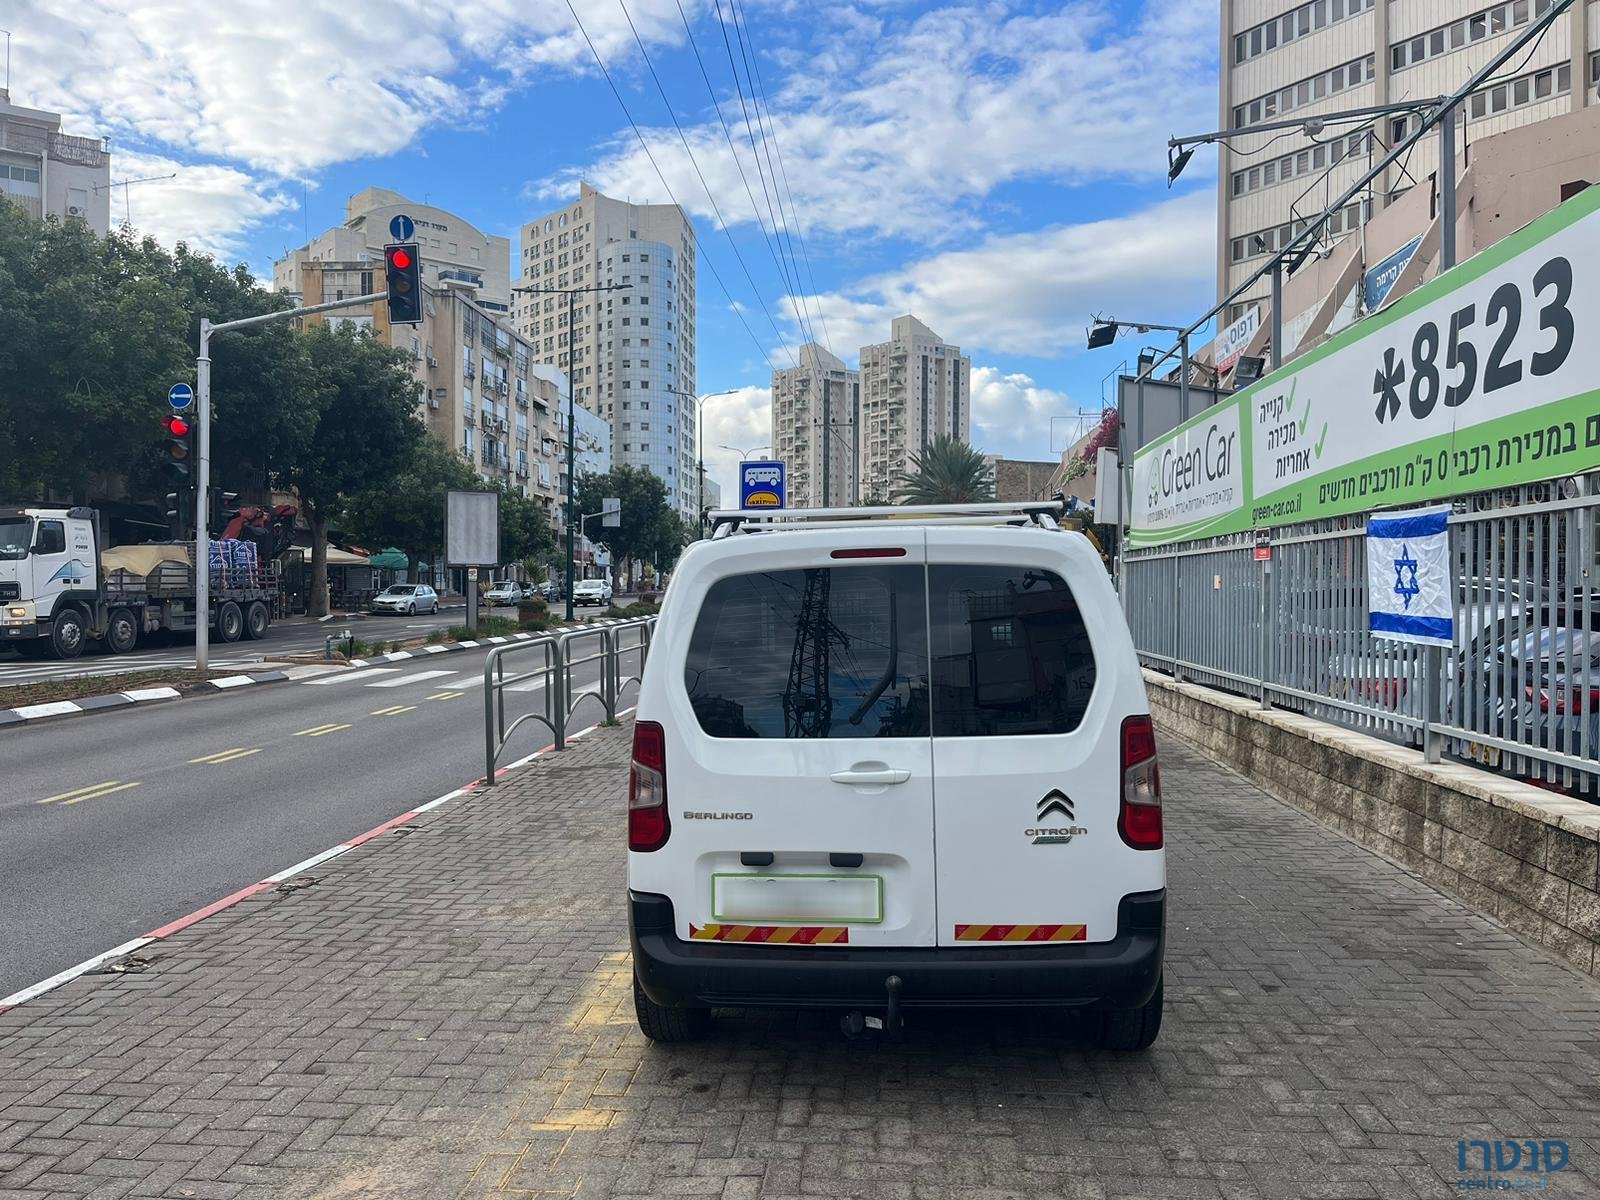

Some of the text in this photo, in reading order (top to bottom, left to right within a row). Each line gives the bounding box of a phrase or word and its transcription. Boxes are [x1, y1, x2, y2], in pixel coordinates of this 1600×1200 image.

[1230, 314, 1253, 344] דפוס
[1259, 394, 1284, 424] קנייה
[1268, 421, 1296, 451] מכירה
[1496, 421, 1577, 469] במכירת
[1162, 424, 1235, 498] Green Car
[1275, 448, 1311, 479] אחריות
[1438, 450, 1448, 481] 0
[1453, 444, 1491, 477] רכבי
[1319, 476, 1356, 505] חדשים
[1359, 465, 1400, 496] ורכבים
[1251, 492, 1302, 525] green-car.co.il
